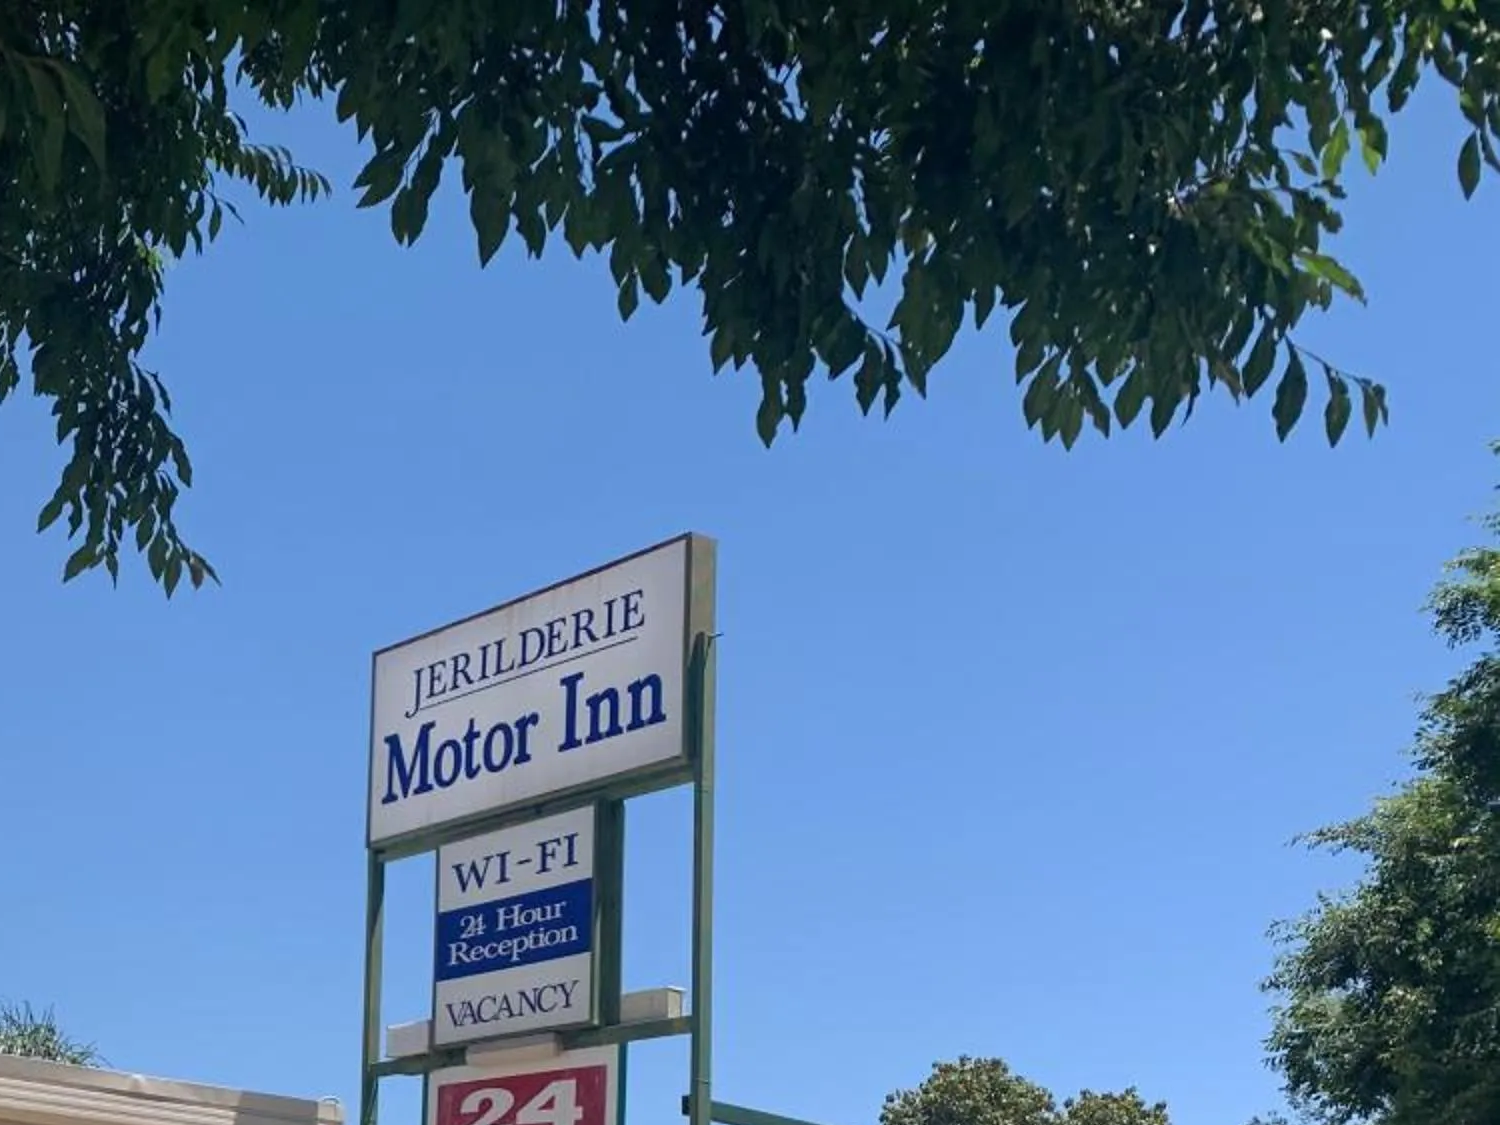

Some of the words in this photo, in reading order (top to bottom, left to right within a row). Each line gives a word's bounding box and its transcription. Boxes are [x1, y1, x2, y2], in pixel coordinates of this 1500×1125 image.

[405, 589, 645, 719] JERILDERIE
[381, 711, 539, 805] Motor
[557, 671, 667, 752] Inn
[452, 832, 579, 893] WI-FI
[447, 924, 579, 966] Reception
[459, 913, 487, 939] 24
[496, 901, 567, 931] Hour
[445, 980, 580, 1028] VACANCY
